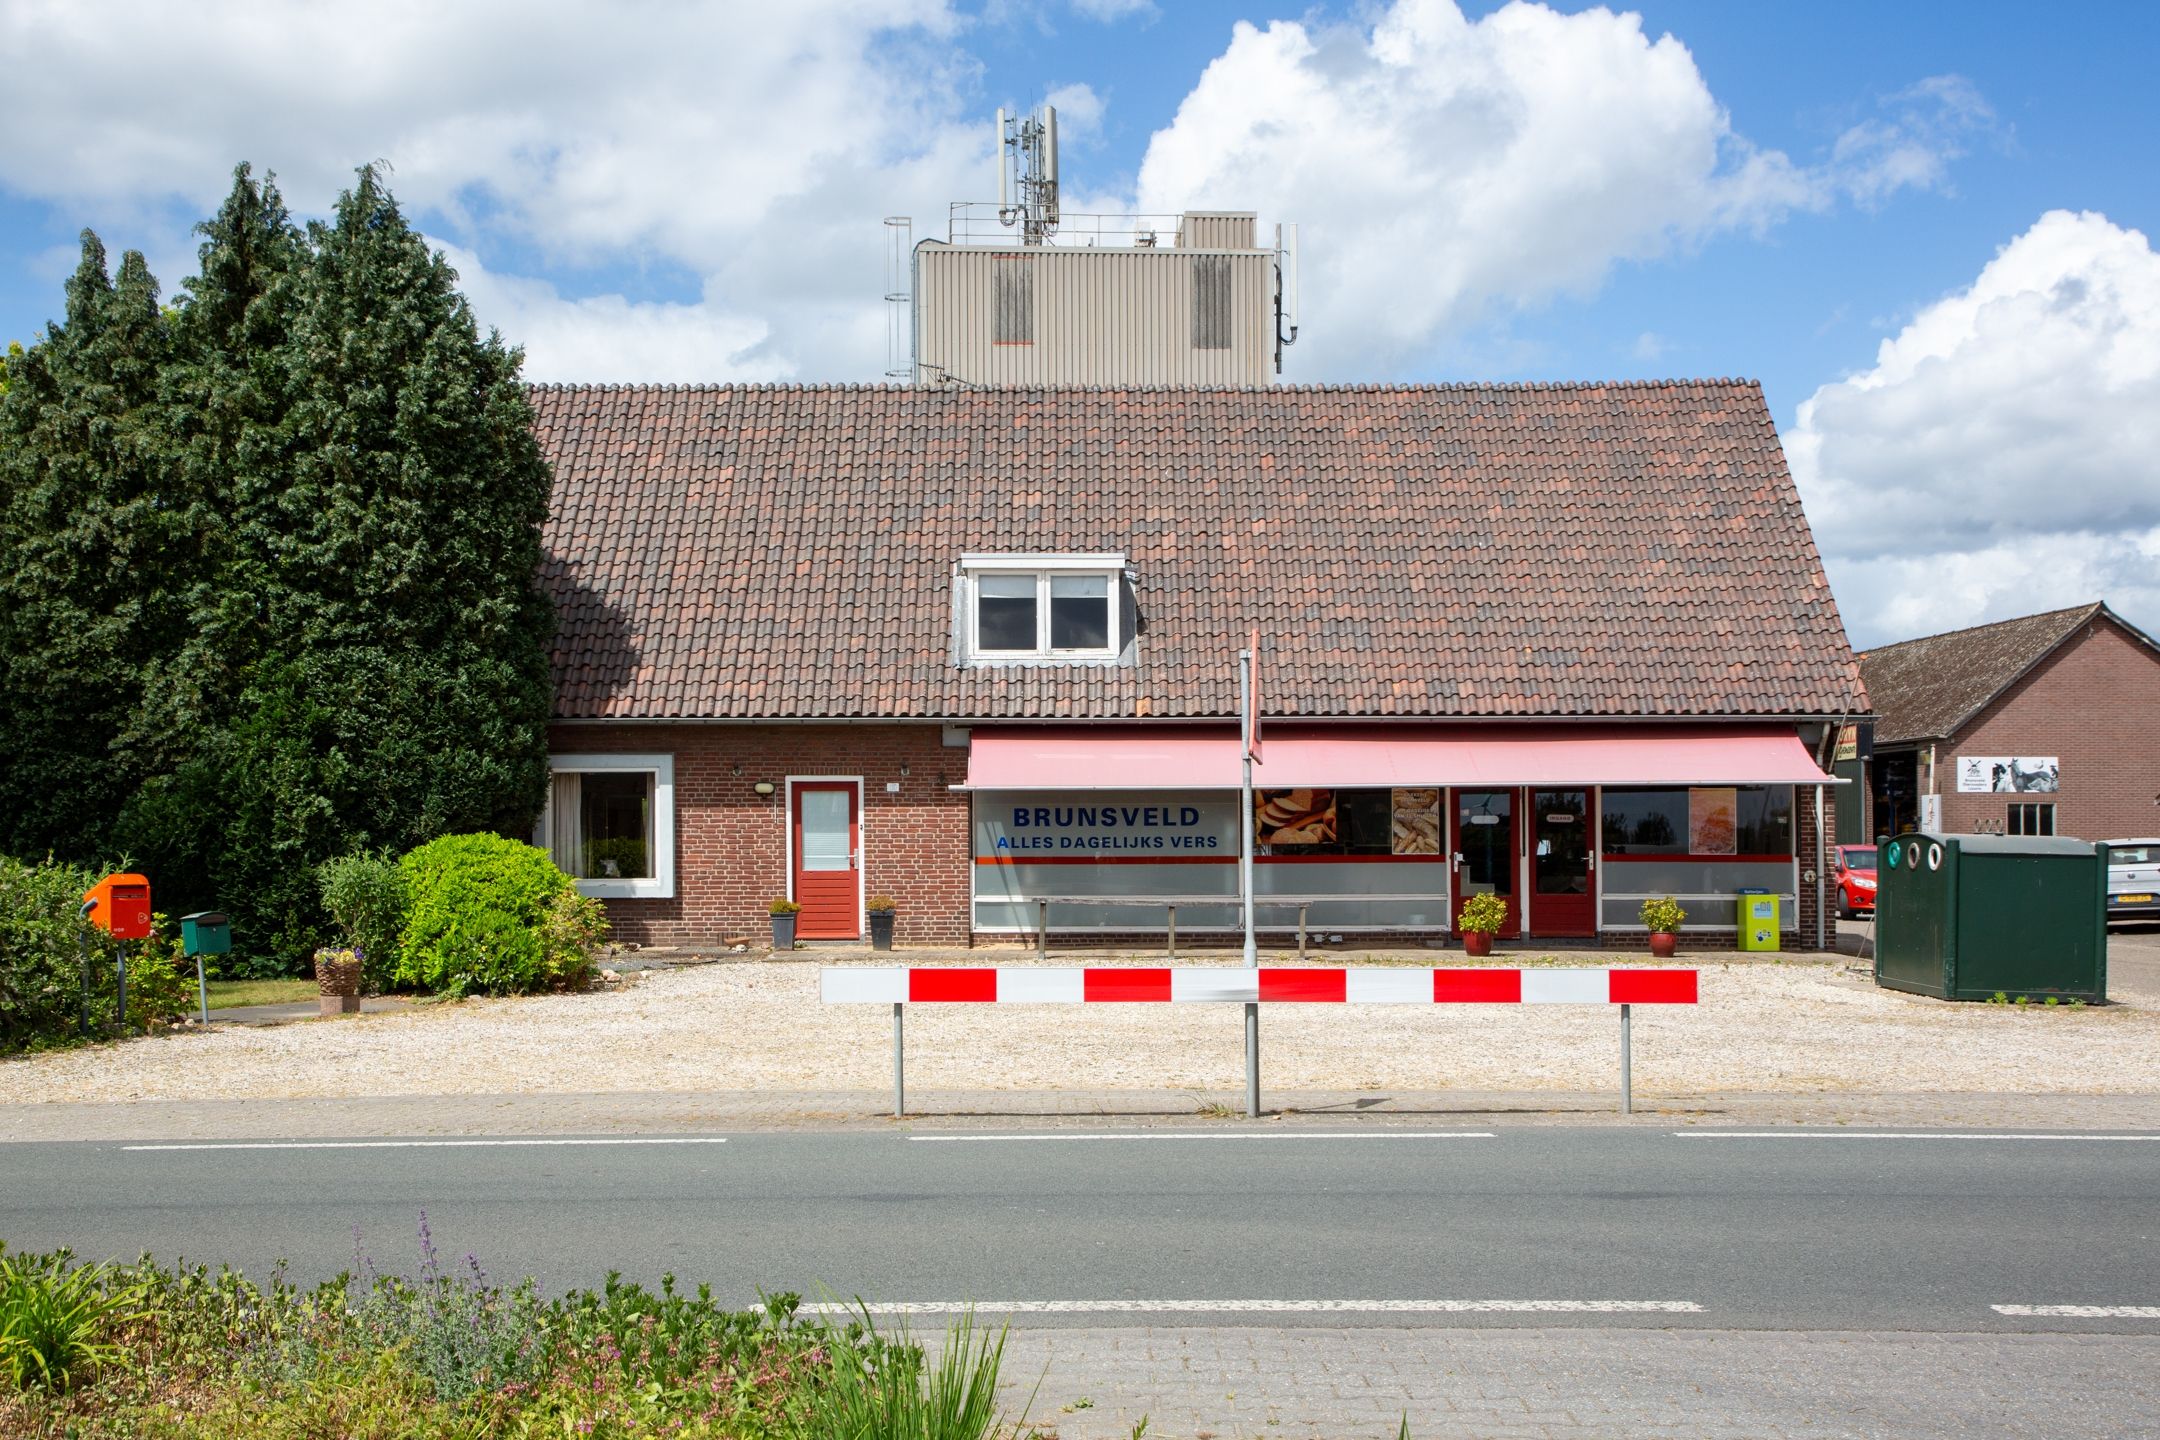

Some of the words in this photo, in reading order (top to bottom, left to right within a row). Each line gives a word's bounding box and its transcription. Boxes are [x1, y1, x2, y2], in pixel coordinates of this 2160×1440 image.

[1013, 807, 1200, 827] BRUNSVELD
[997, 836, 1053, 849] ALLES
[1060, 836, 1164, 849] DAGELIJKS
[1170, 836, 1217, 848] VERS
